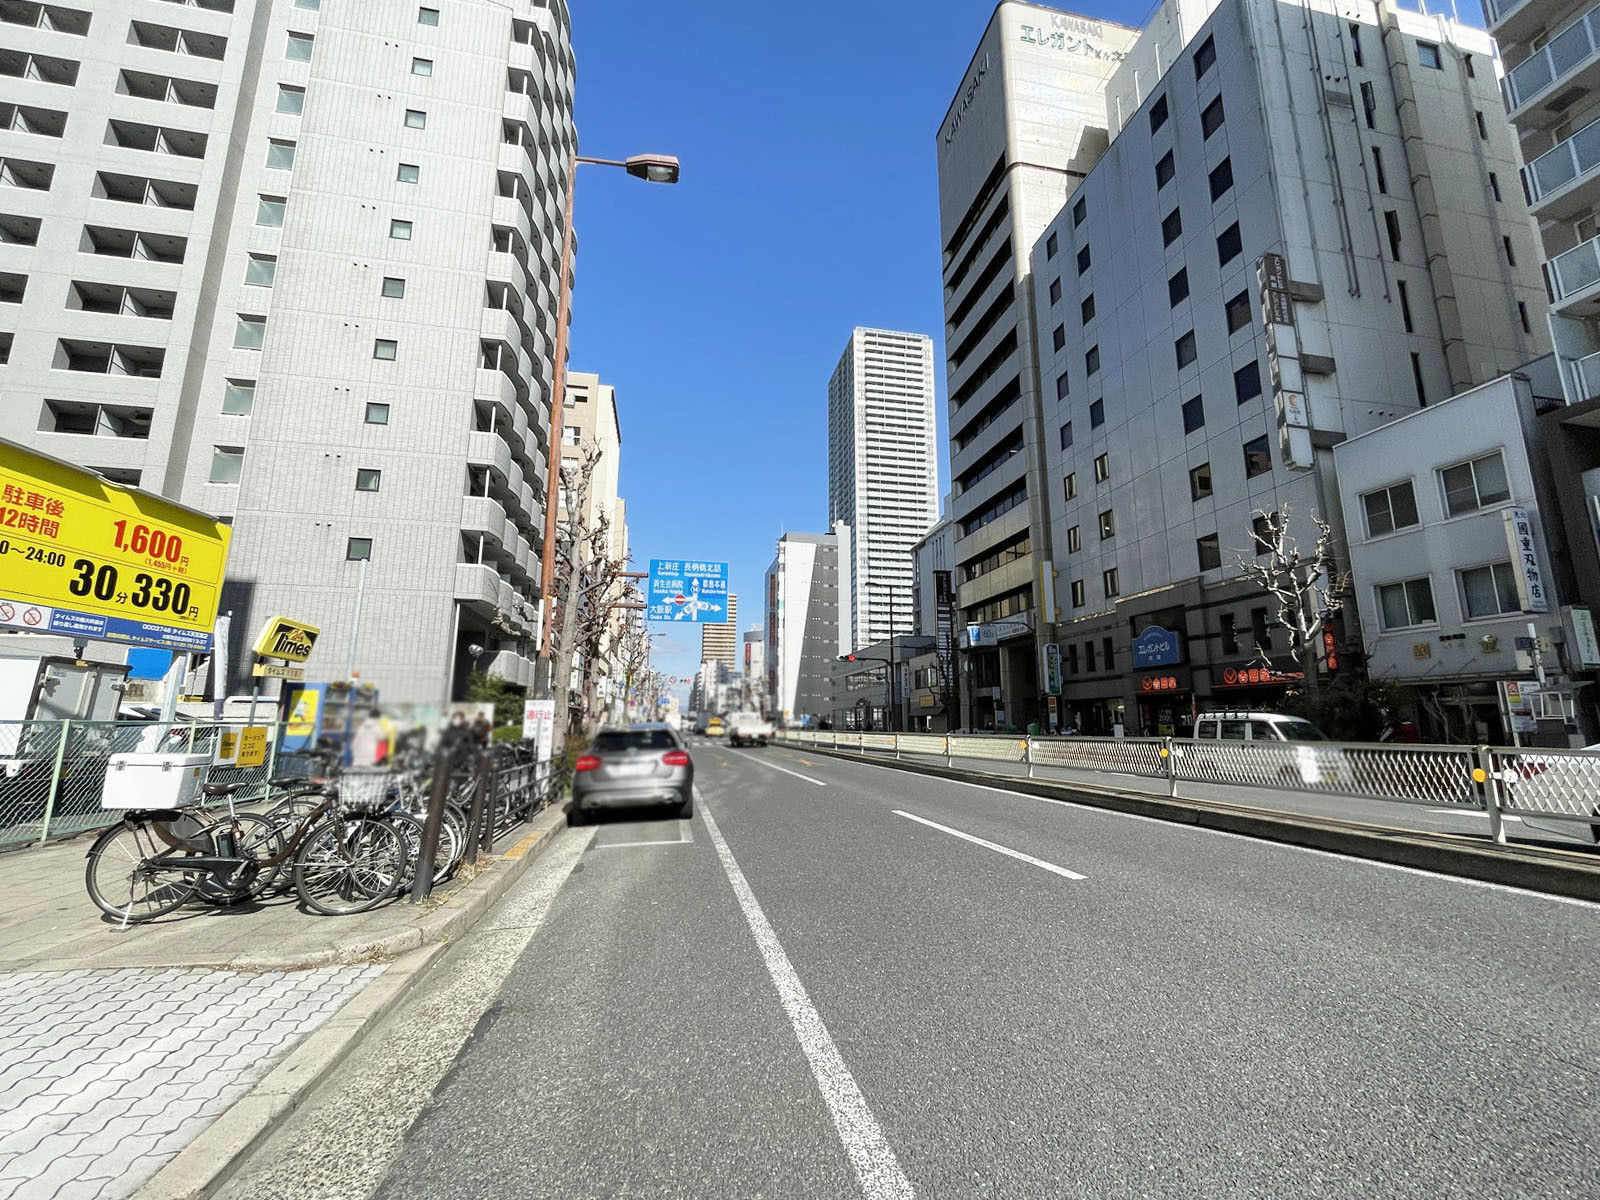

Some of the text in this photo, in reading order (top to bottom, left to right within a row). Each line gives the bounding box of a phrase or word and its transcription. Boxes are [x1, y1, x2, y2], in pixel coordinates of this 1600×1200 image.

[1050, 14, 1103, 39] KAWASAKI
[945, 52, 989, 150] KAWASAKI
[1, 483, 65, 519] 駐車後
[0, 506, 60, 539] 12時間
[113, 519, 190, 567] 1,600円
[69, 559, 199, 618] 30分 330円
[649, 604, 673, 614] 大阪駅
[273, 632, 312, 656] Times
